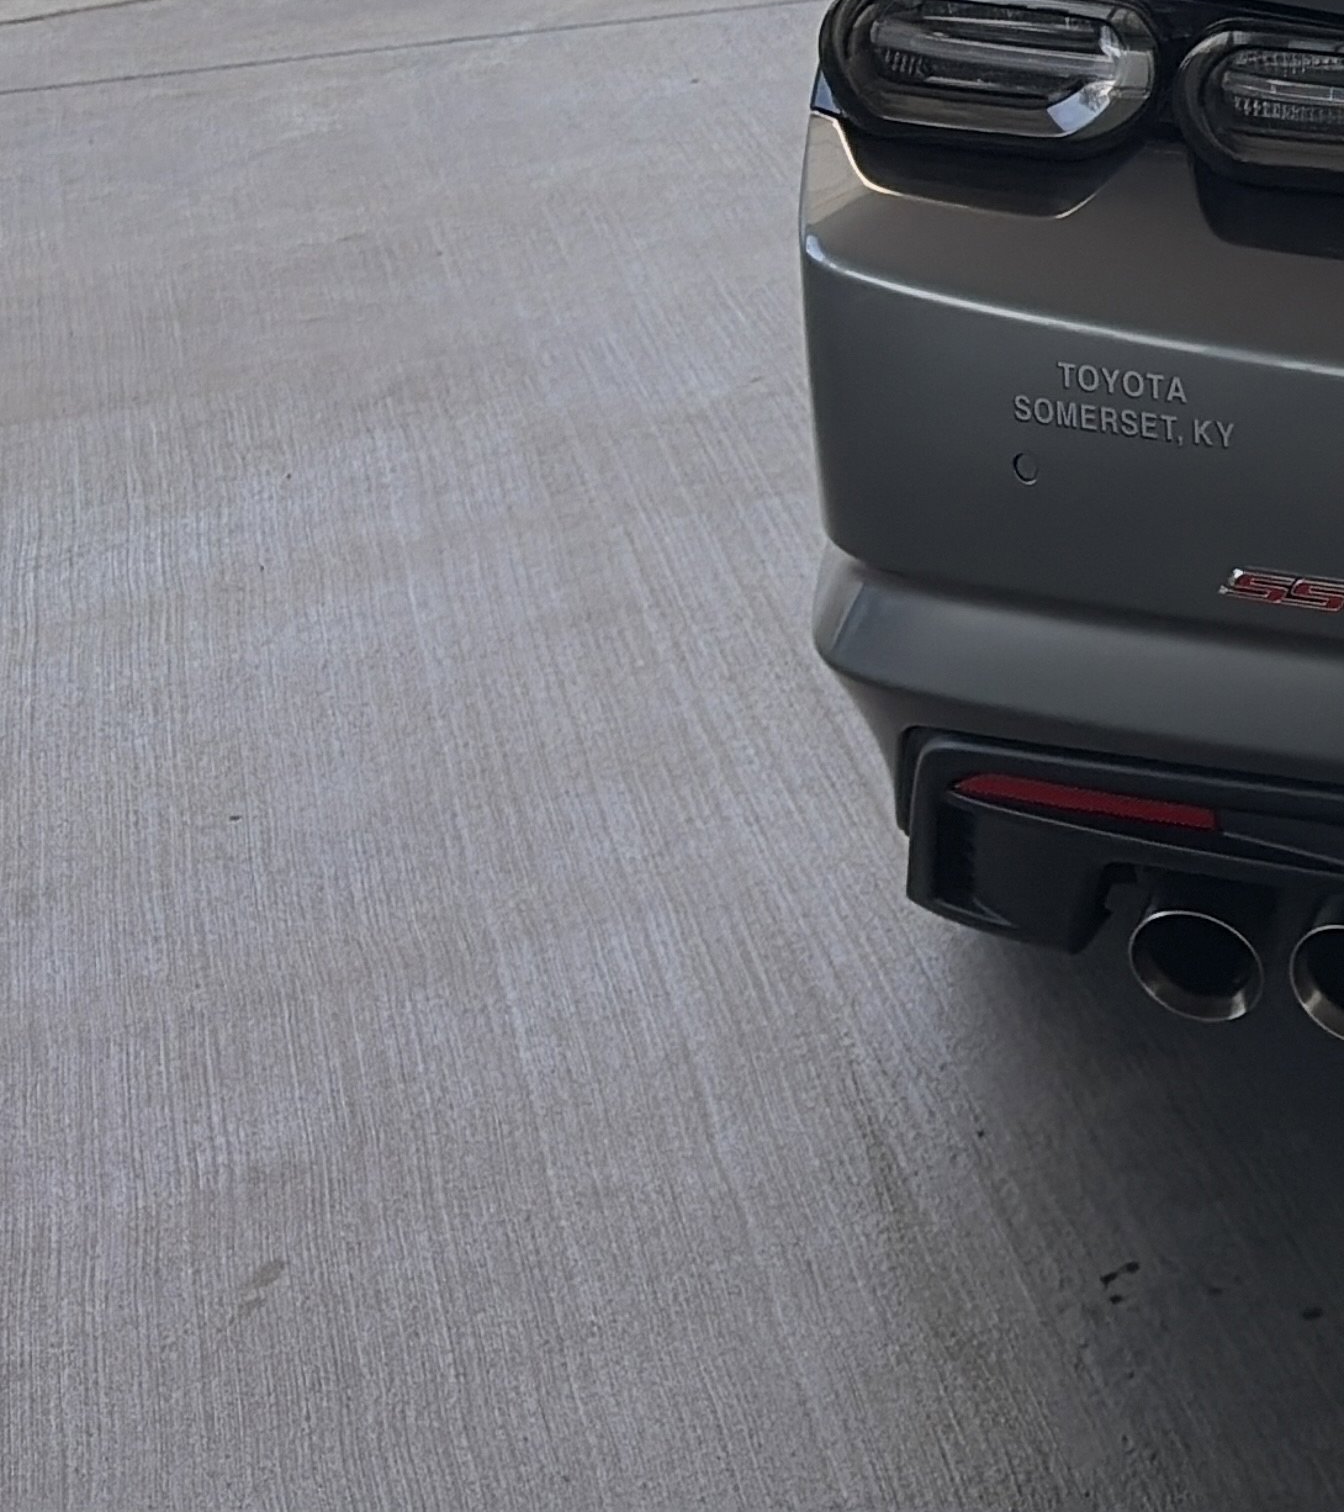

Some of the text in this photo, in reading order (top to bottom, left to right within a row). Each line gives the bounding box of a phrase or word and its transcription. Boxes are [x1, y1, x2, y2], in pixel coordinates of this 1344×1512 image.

[1057, 362, 1187, 403] TOYOTA
[1013, 395, 1234, 448] SOMERSET, KY
